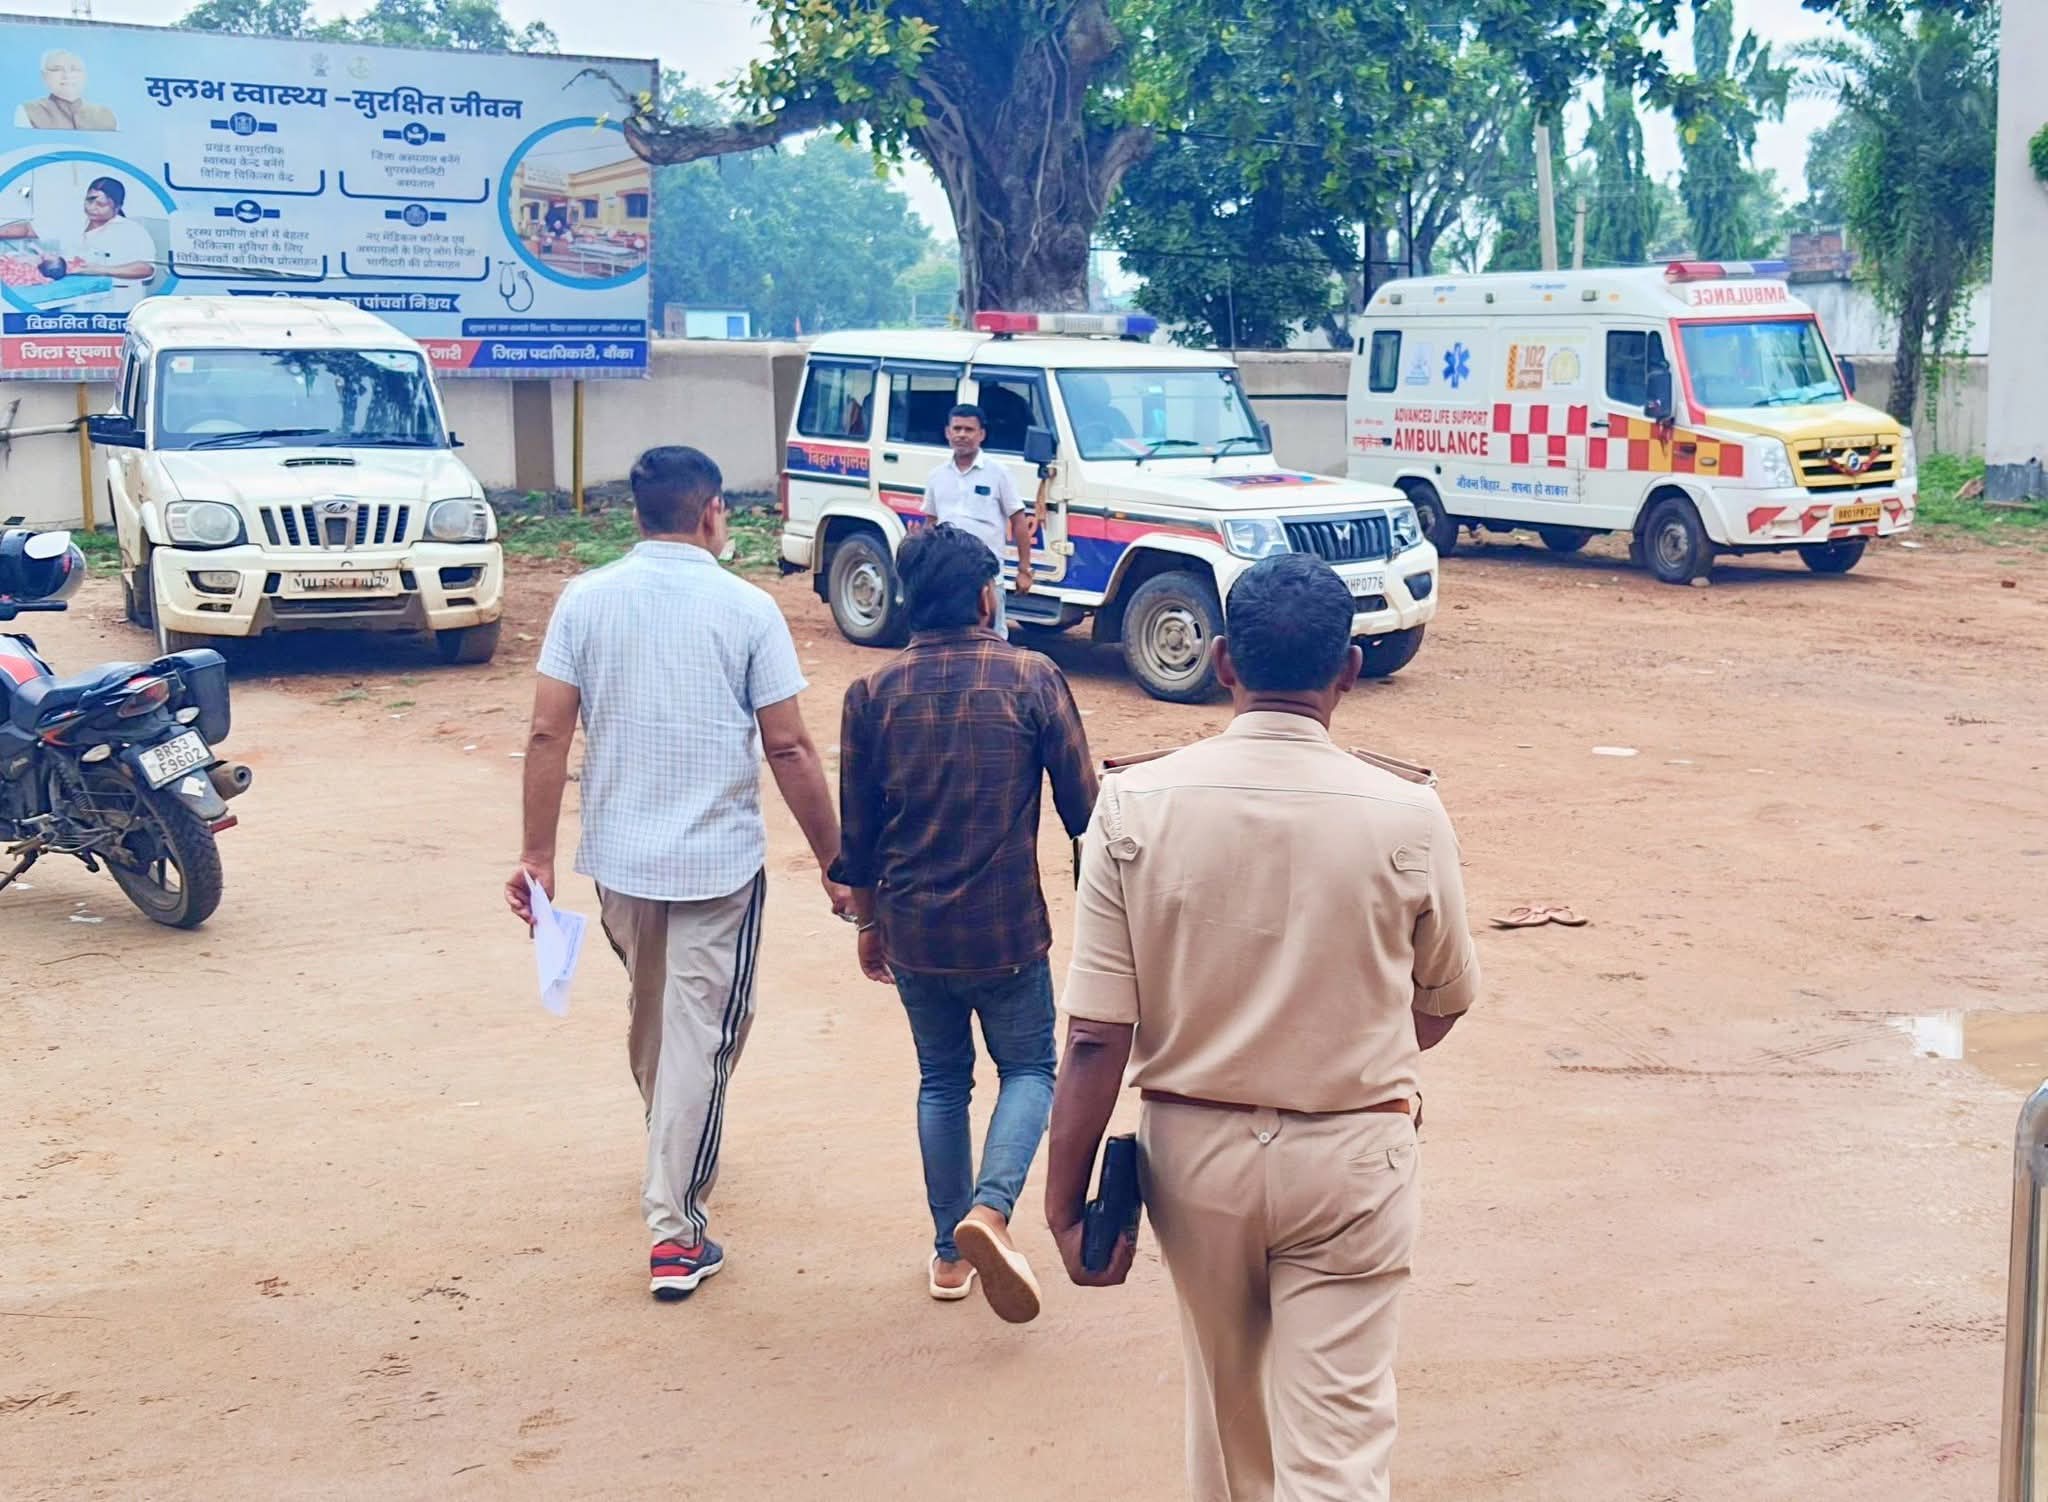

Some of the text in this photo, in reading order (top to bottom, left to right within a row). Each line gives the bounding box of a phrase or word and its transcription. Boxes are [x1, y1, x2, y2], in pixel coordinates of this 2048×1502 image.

[145, 77, 225, 107] सुलभ
[230, 82, 327, 107] स्वास्थ्य
[450, 91, 523, 119] जीवन
[409, 294, 451, 310] निश्चय
[25, 314, 89, 330] विकसित
[21, 342, 64, 360] जिला
[66, 345, 112, 365] सूचना
[432, 344, 462, 361] जारी
[492, 344, 527, 361] जिला
[1524, 344, 1546, 368] 102
[1394, 408, 1432, 423] ADVANCED
[1434, 409, 1450, 424] LIFE
[1452, 410, 1489, 426] SUPPORT
[1394, 428, 1489, 457] AMBULANCE
[154, 737, 190, 762] BR53
[159, 747, 203, 775] F9602
